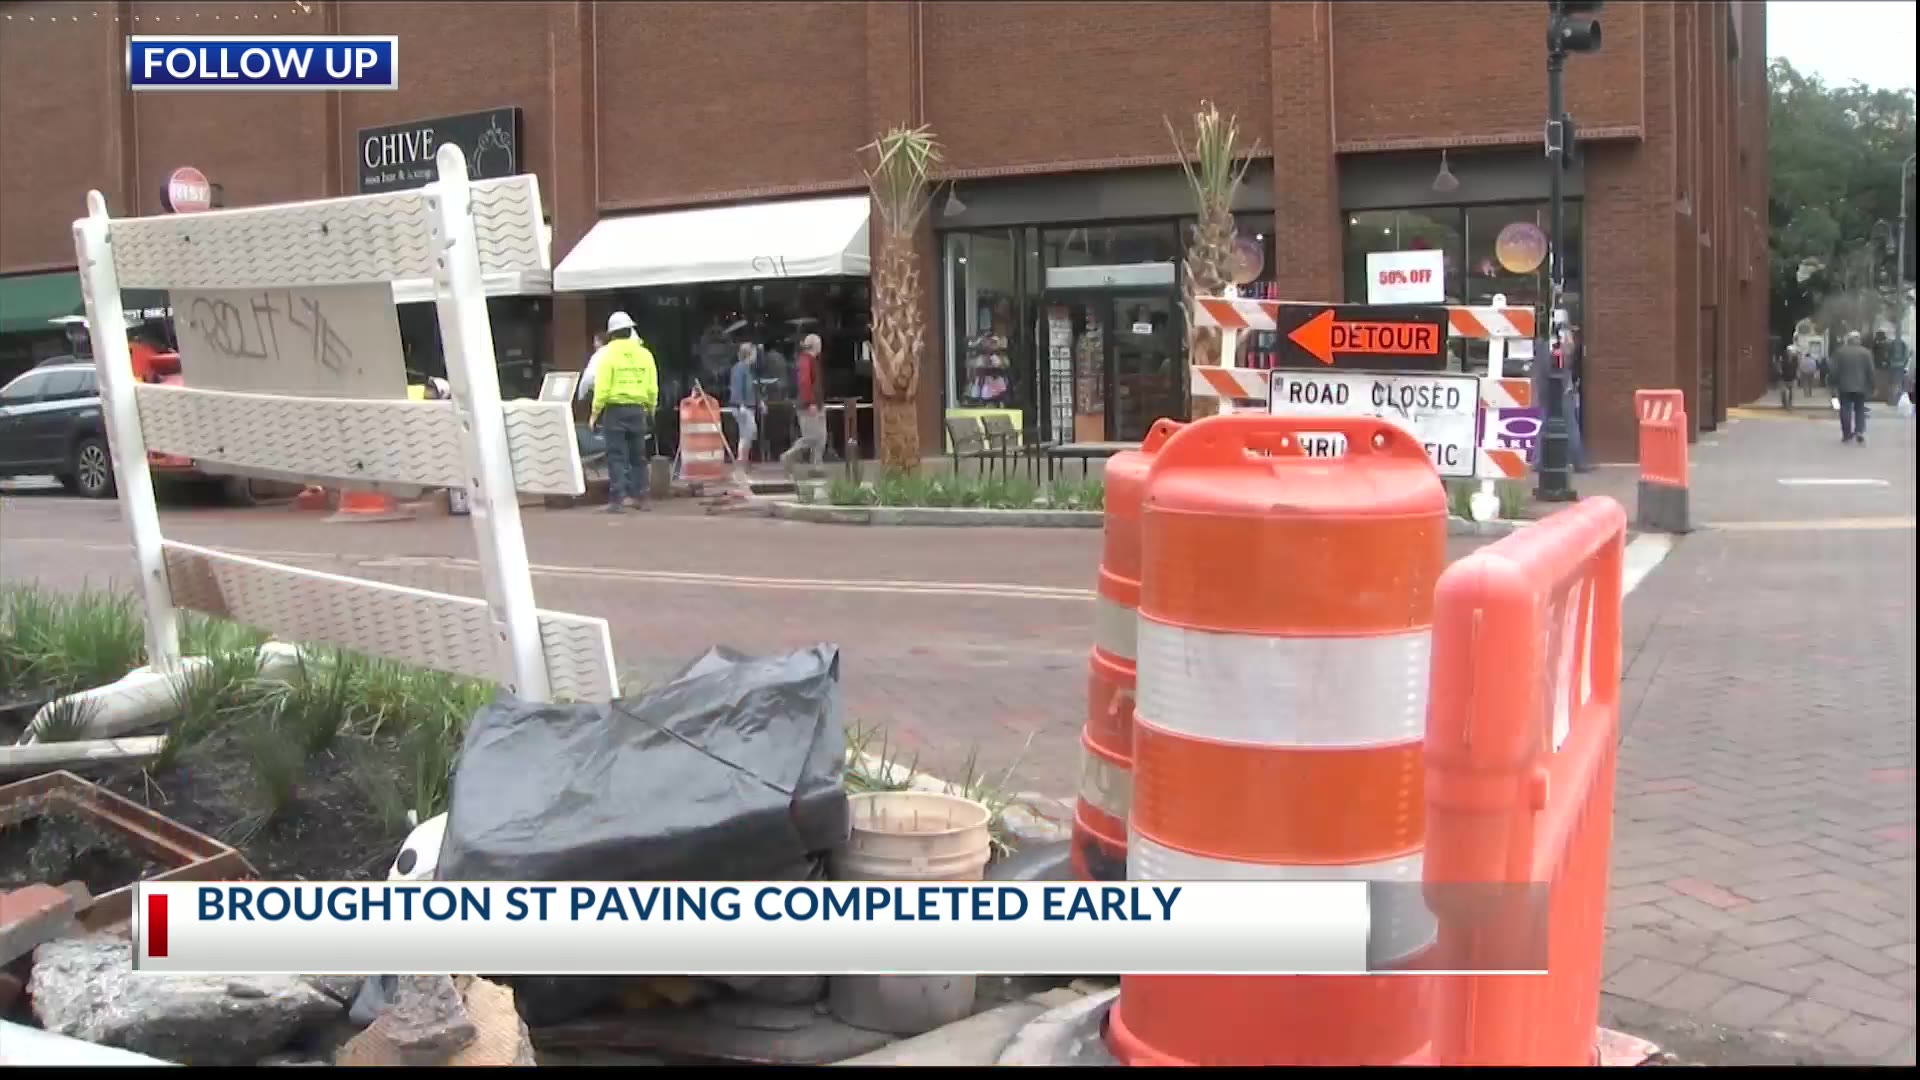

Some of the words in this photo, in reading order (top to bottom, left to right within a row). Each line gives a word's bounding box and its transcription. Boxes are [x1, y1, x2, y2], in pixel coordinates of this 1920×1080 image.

[365, 128, 436, 168] CHIVE
[1379, 269, 1407, 285] 50%
[1410, 268, 1433, 284] OFF
[1331, 325, 1431, 350] DETOUR
[1289, 381, 1349, 405] ROAD
[1371, 384, 1460, 410] CLOSED
[1300, 437, 1345, 457] HRU
